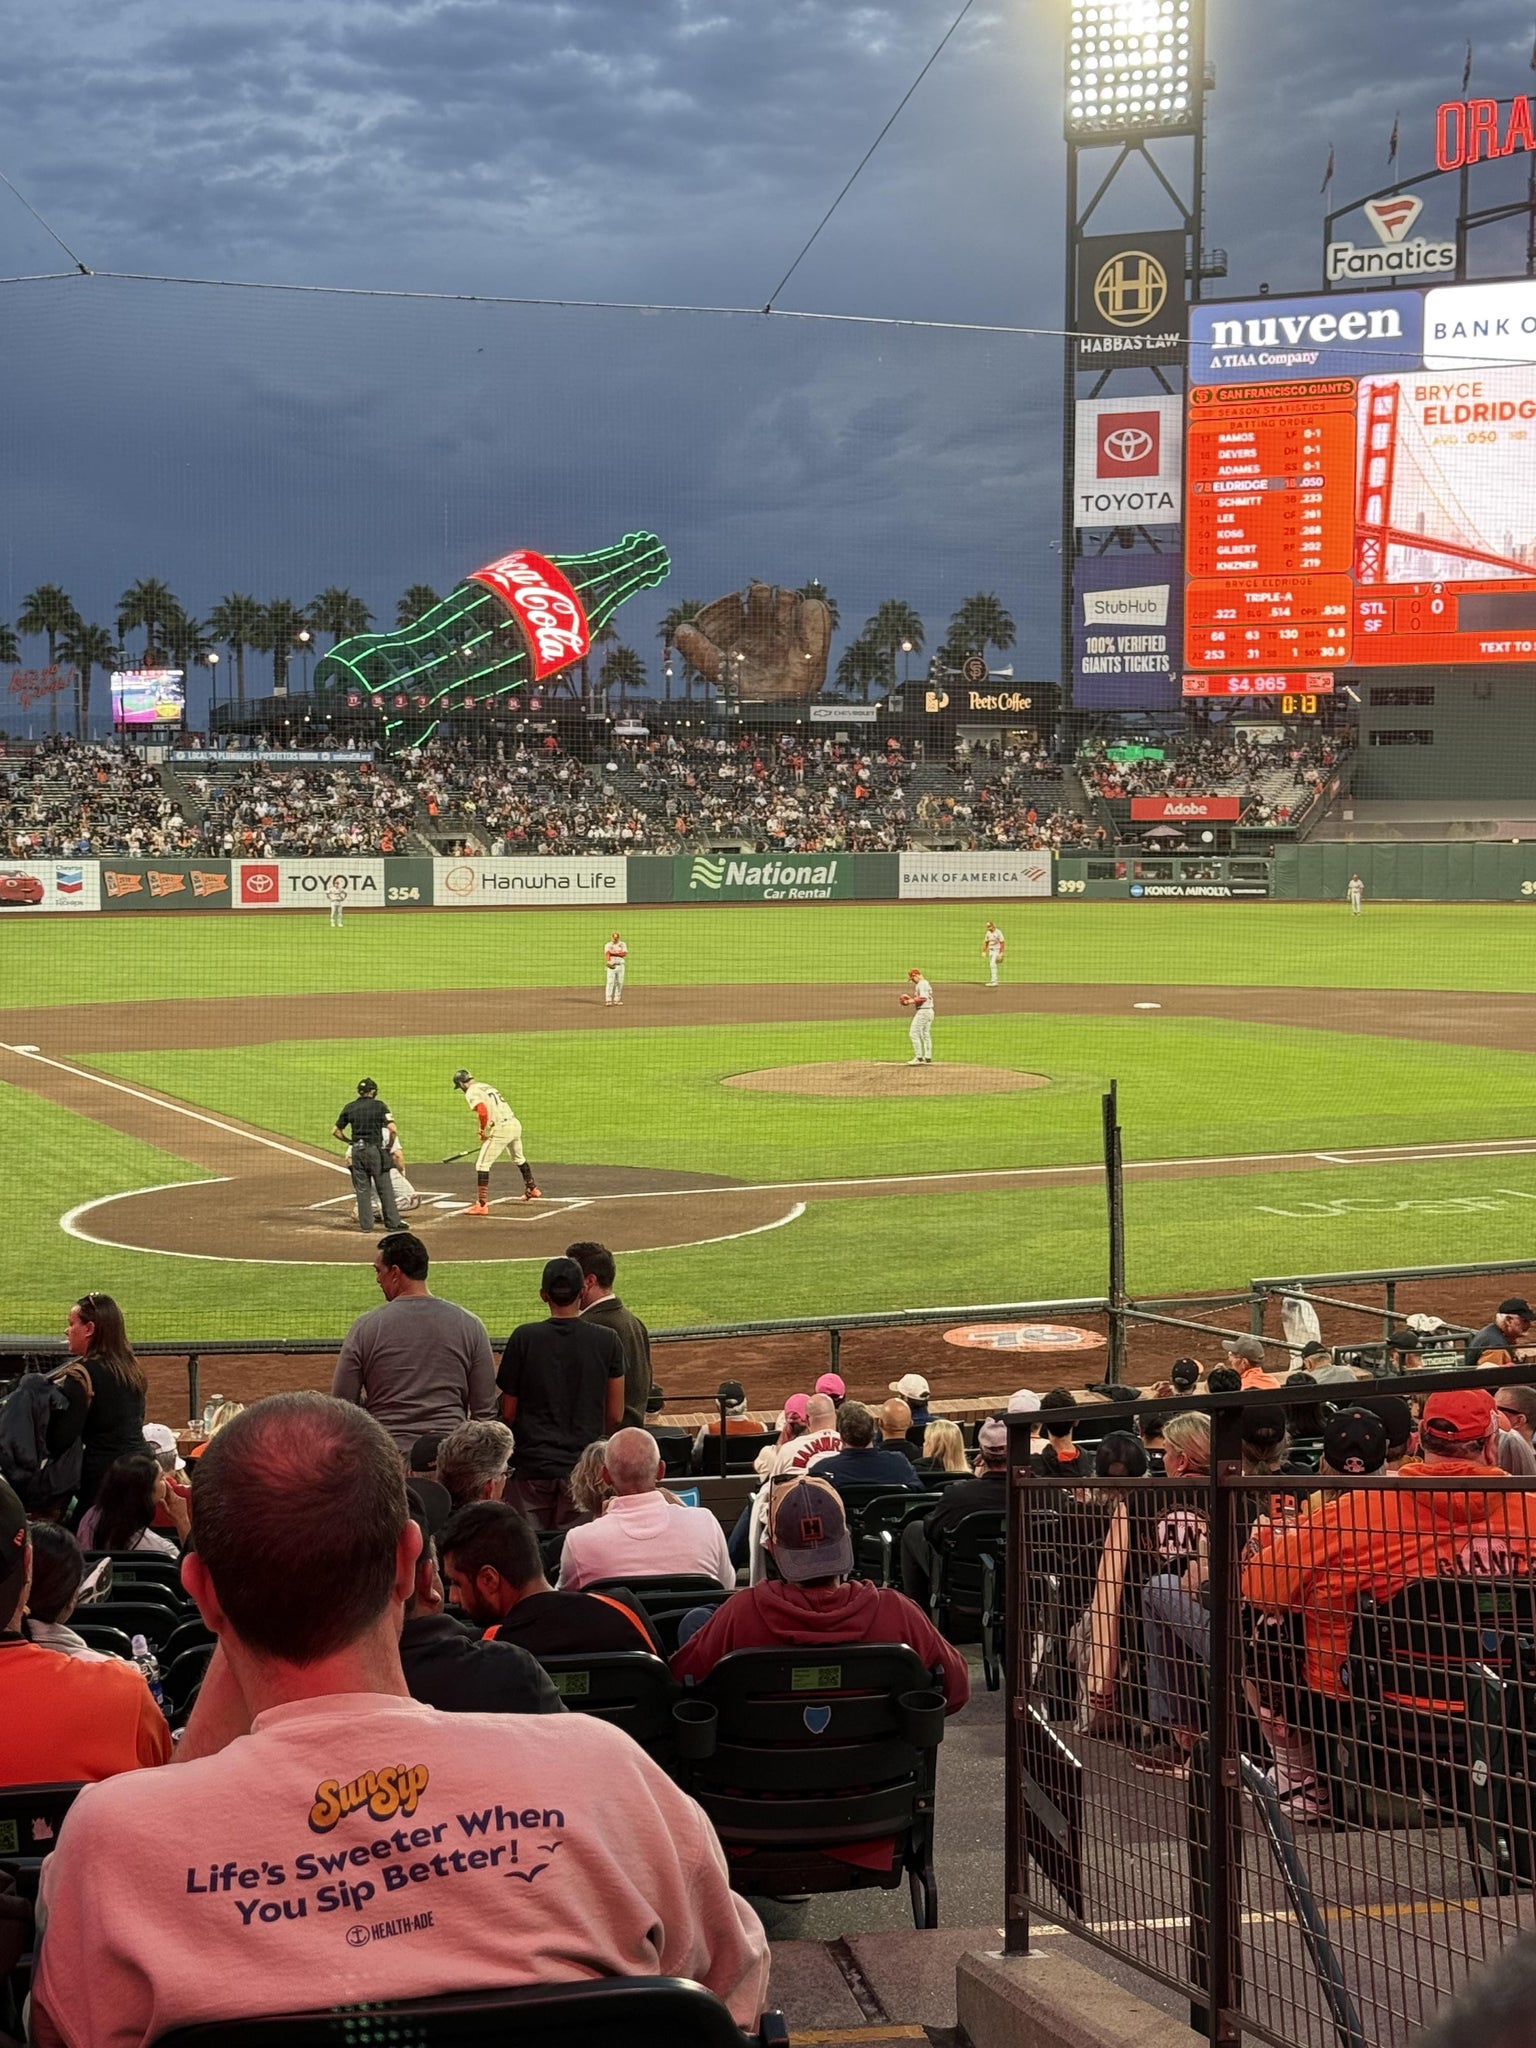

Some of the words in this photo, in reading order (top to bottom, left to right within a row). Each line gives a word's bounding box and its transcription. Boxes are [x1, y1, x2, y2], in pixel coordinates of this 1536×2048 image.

[1332, 242, 1454, 274] Fanatics
[1211, 308, 1402, 349] nuveen
[1434, 318, 1510, 340] BANK
[1081, 335, 1143, 354] HABBAS
[1146, 333, 1180, 350] LAW
[1210, 356, 1222, 368] A
[1223, 354, 1257, 368] TIAA
[1258, 351, 1319, 367] Company
[1220, 389, 1243, 401] SAN
[1244, 385, 1307, 399] FRANCISCO
[1309, 382, 1351, 395] GIANTS
[1415, 382, 1483, 400] BRYCE
[1218, 408, 1260, 417] SEASON
[1264, 404, 1326, 415] STATISTICS
[1424, 400, 1536, 426] ELDRIDG
[1230, 419, 1276, 430] BATTING
[1279, 417, 1314, 427] ORDER
[1218, 432, 1255, 443] RAMOS
[1218, 448, 1257, 459] DEVERS
[1218, 464, 1261, 476] ADAMES
[1213, 479, 1269, 492] ELDRIDGE
[1300, 477, 1324, 487] .050
[1082, 492, 1174, 512] TOYOTA
[1217, 496, 1262, 508] SCHMITT
[1217, 513, 1235, 523] LEE
[1216, 544, 1257, 555] GILBERT
[1225, 579, 1258, 588] BRYCE
[1262, 577, 1313, 587] ELDRIDGE
[1433, 584, 1442, 594] 2
[1244, 592, 1293, 603] TRIPLE-A
[1094, 600, 1157, 614] StubHub
[1360, 602, 1387, 615] STL
[1411, 600, 1421, 614] 0
[1431, 599, 1444, 614] 0
[1363, 619, 1383, 632] SF
[1086, 637, 1116, 653] 100%
[1117, 635, 1166, 653] VERIFIED
[1479, 642, 1511, 653] TEXT
[1514, 641, 1531, 652] TO
[1082, 656, 1122, 673] GIANTS
[1123, 655, 1170, 672] TICKETS
[1228, 676, 1287, 693] $4,965
[969, 691, 998, 711] Peet's
[998, 692, 1032, 712] Coffee
[834, 709, 875, 717] CHEVROLET
[1163, 803, 1208, 816] Adobe
[725, 861, 837, 885] National
[904, 873, 938, 884] BANK
[942, 873, 958, 883] OF
[961, 871, 1018, 883] AMERICA
[288, 875, 377, 892] TOYOTA
[482, 873, 570, 890] Hanwha
[576, 873, 617, 890] Life
[1058, 880, 1086, 893] 399
[1521, 881, 1536, 895] 3
[388, 887, 420, 900] 354
[763, 887, 786, 899] Car
[788, 887, 831, 899] Rental
[1144, 886, 1184, 896] KONICA
[1185, 886, 1231, 897] MINOLTA
[308, 1763, 430, 1834] SunSip
[186, 1861, 286, 1894] Life's
[295, 1821, 448, 1881] Sweeter
[455, 1805, 565, 1839] When
[235, 1895, 308, 1925] You
[317, 1880, 375, 1912] Sip
[381, 1839, 519, 1893] Better!
